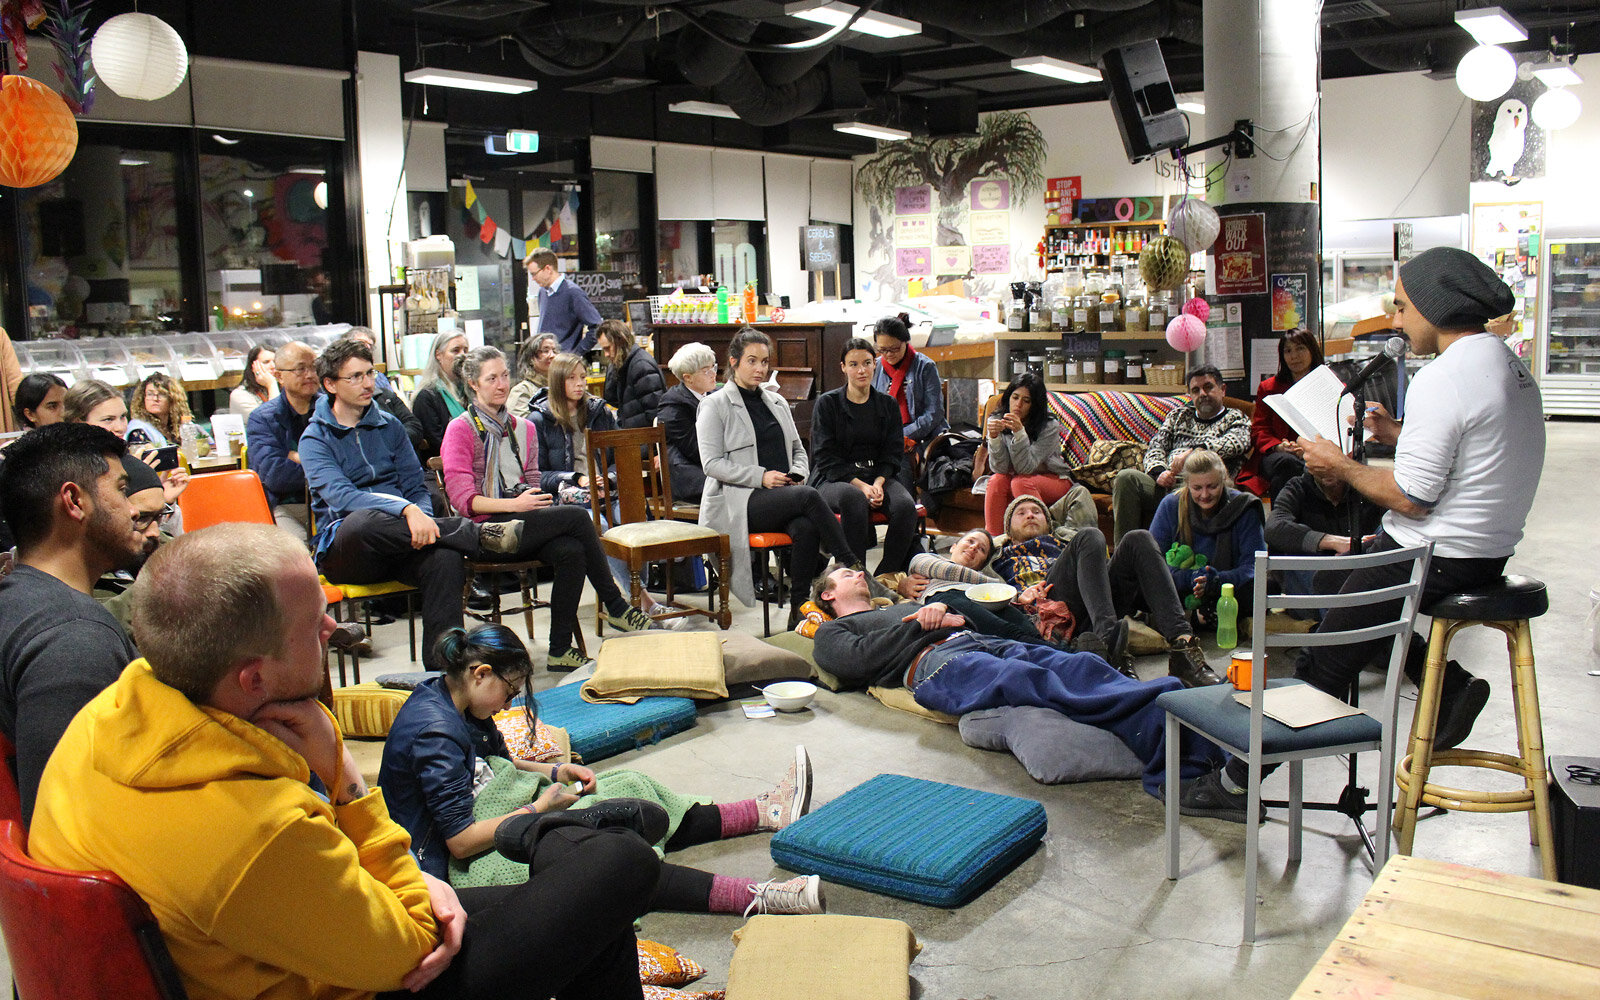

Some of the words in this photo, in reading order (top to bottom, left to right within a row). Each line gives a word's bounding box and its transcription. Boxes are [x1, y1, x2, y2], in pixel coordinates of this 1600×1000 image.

[1056, 180, 1072, 189] STOP
[1060, 197, 1072, 206] OAL
[1077, 196, 1154, 223] FOOD
[807, 228, 835, 239] CEREALS
[1225, 230, 1248, 241] WALK
[1225, 239, 1247, 251] OUT
[809, 251, 832, 263] SEEDS
[576, 273, 606, 286] FOOD
